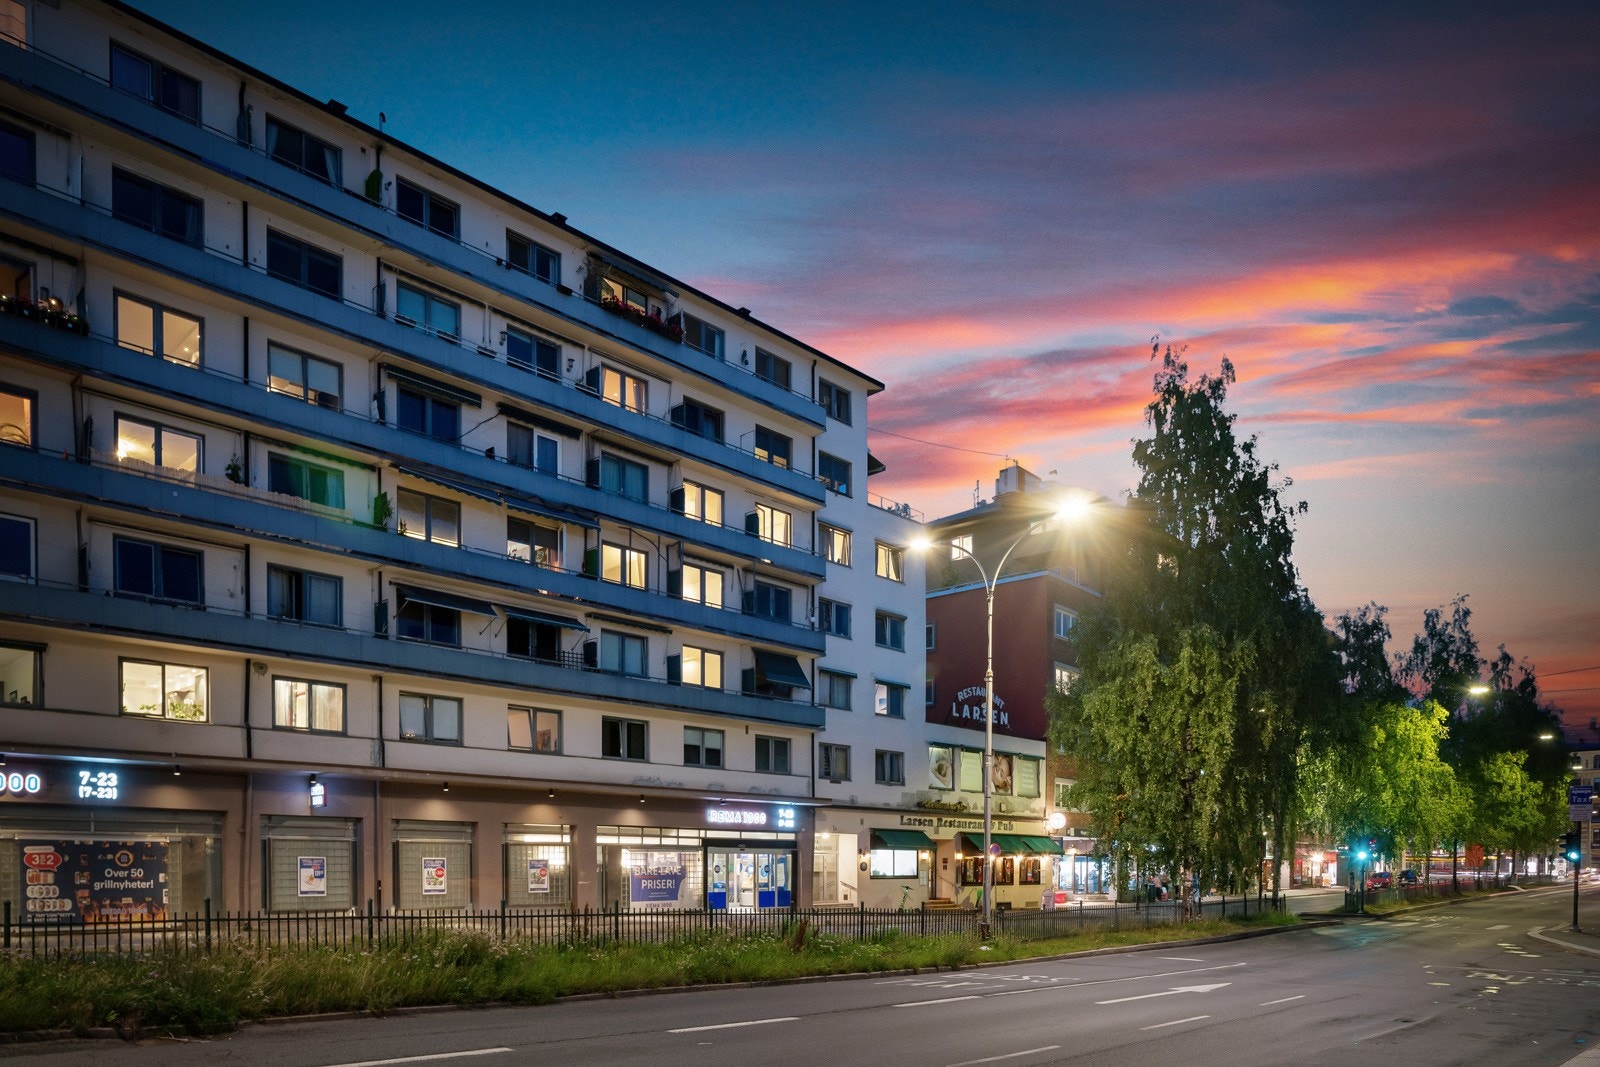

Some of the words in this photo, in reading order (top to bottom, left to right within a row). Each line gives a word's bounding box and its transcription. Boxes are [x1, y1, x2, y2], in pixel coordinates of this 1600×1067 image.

[79, 770, 118, 787] 7-23
[79, 785, 118, 800] (7-23)
[709, 809, 742, 823] REMA
[743, 811, 767, 825] 1000
[900, 814, 934, 827] Larsen
[936, 817, 989, 830] Restauran
[998, 821, 1014, 831] Pub
[31, 854, 40, 865] 3
[46, 854, 55, 865] 2
[104, 868, 129, 878] Over
[130, 868, 144, 878] 50
[634, 866, 659, 876] BARE
[660, 865, 682, 876] LAVE
[93, 879, 154, 891] grillnyheter!
[641, 879, 676, 890] PRISER!
